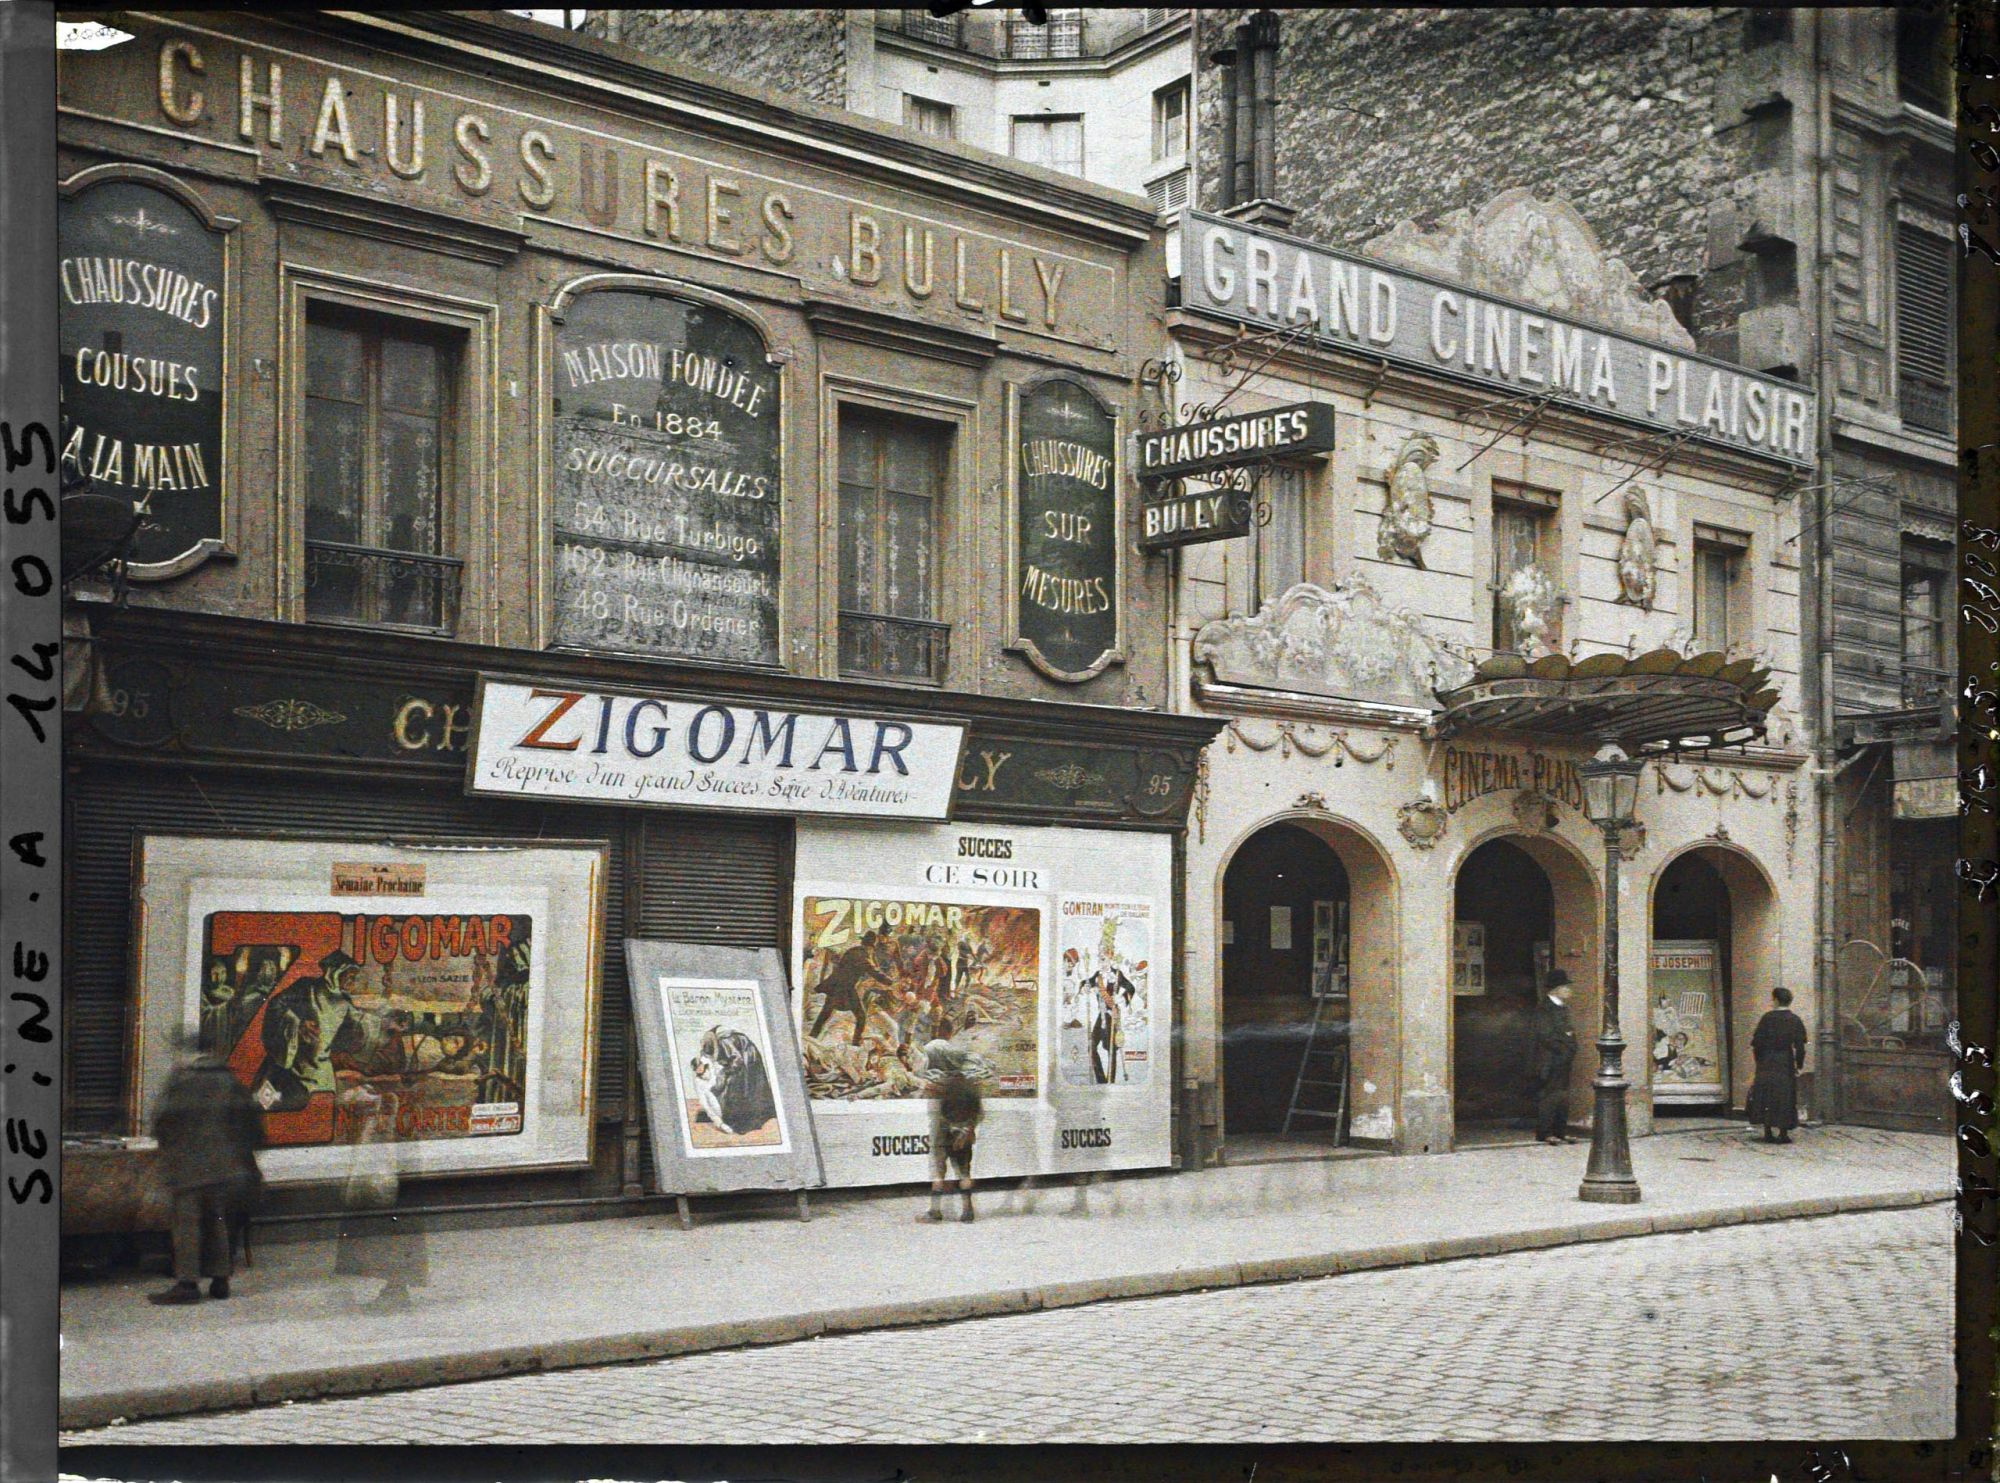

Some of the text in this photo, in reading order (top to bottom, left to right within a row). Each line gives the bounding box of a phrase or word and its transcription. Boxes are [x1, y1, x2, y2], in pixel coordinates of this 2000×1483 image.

[158, 38, 1066, 329] CHAUSSURES BULLY
[61, 257, 218, 329] CHAUSSURES
[1202, 226, 1810, 456] GRAND CINEMA PLAISIR
[76, 347, 198, 402] COUSUES
[563, 342, 767, 418] MAISON FONDÉE
[612, 403, 722, 441] En 1884
[1145, 410, 1309, 468] CHAUSSURES
[90, 434, 123, 486] LA
[132, 443, 210, 491] MAIN
[564, 447, 768, 500] SUCCURSALES
[1022, 440, 1112, 490] CHAUSSURES
[624, 508, 666, 542] Rue
[674, 512, 758, 562] Turbigo
[1044, 510, 1092, 545] SUR
[1146, 496, 1224, 537] BULLY
[574, 590, 761, 636] 48 Rue Ordener
[1022, 565, 1110, 615] MESURES
[112, 689, 150, 718] 95
[514, 687, 915, 777] ZIGOMAR
[490, 757, 578, 791] Reprise
[628, 770, 696, 800] grand
[1149, 774, 1172, 796] 95
[958, 836, 1013, 859] SUCCES
[926, 864, 1039, 889] CE SOIR
[815, 899, 963, 948] ZIGOMAR
[1063, 901, 1104, 916] GONTRAN
[872, 1135, 930, 1157] SUCCES
[1061, 1128, 1111, 1149] SUCCES
